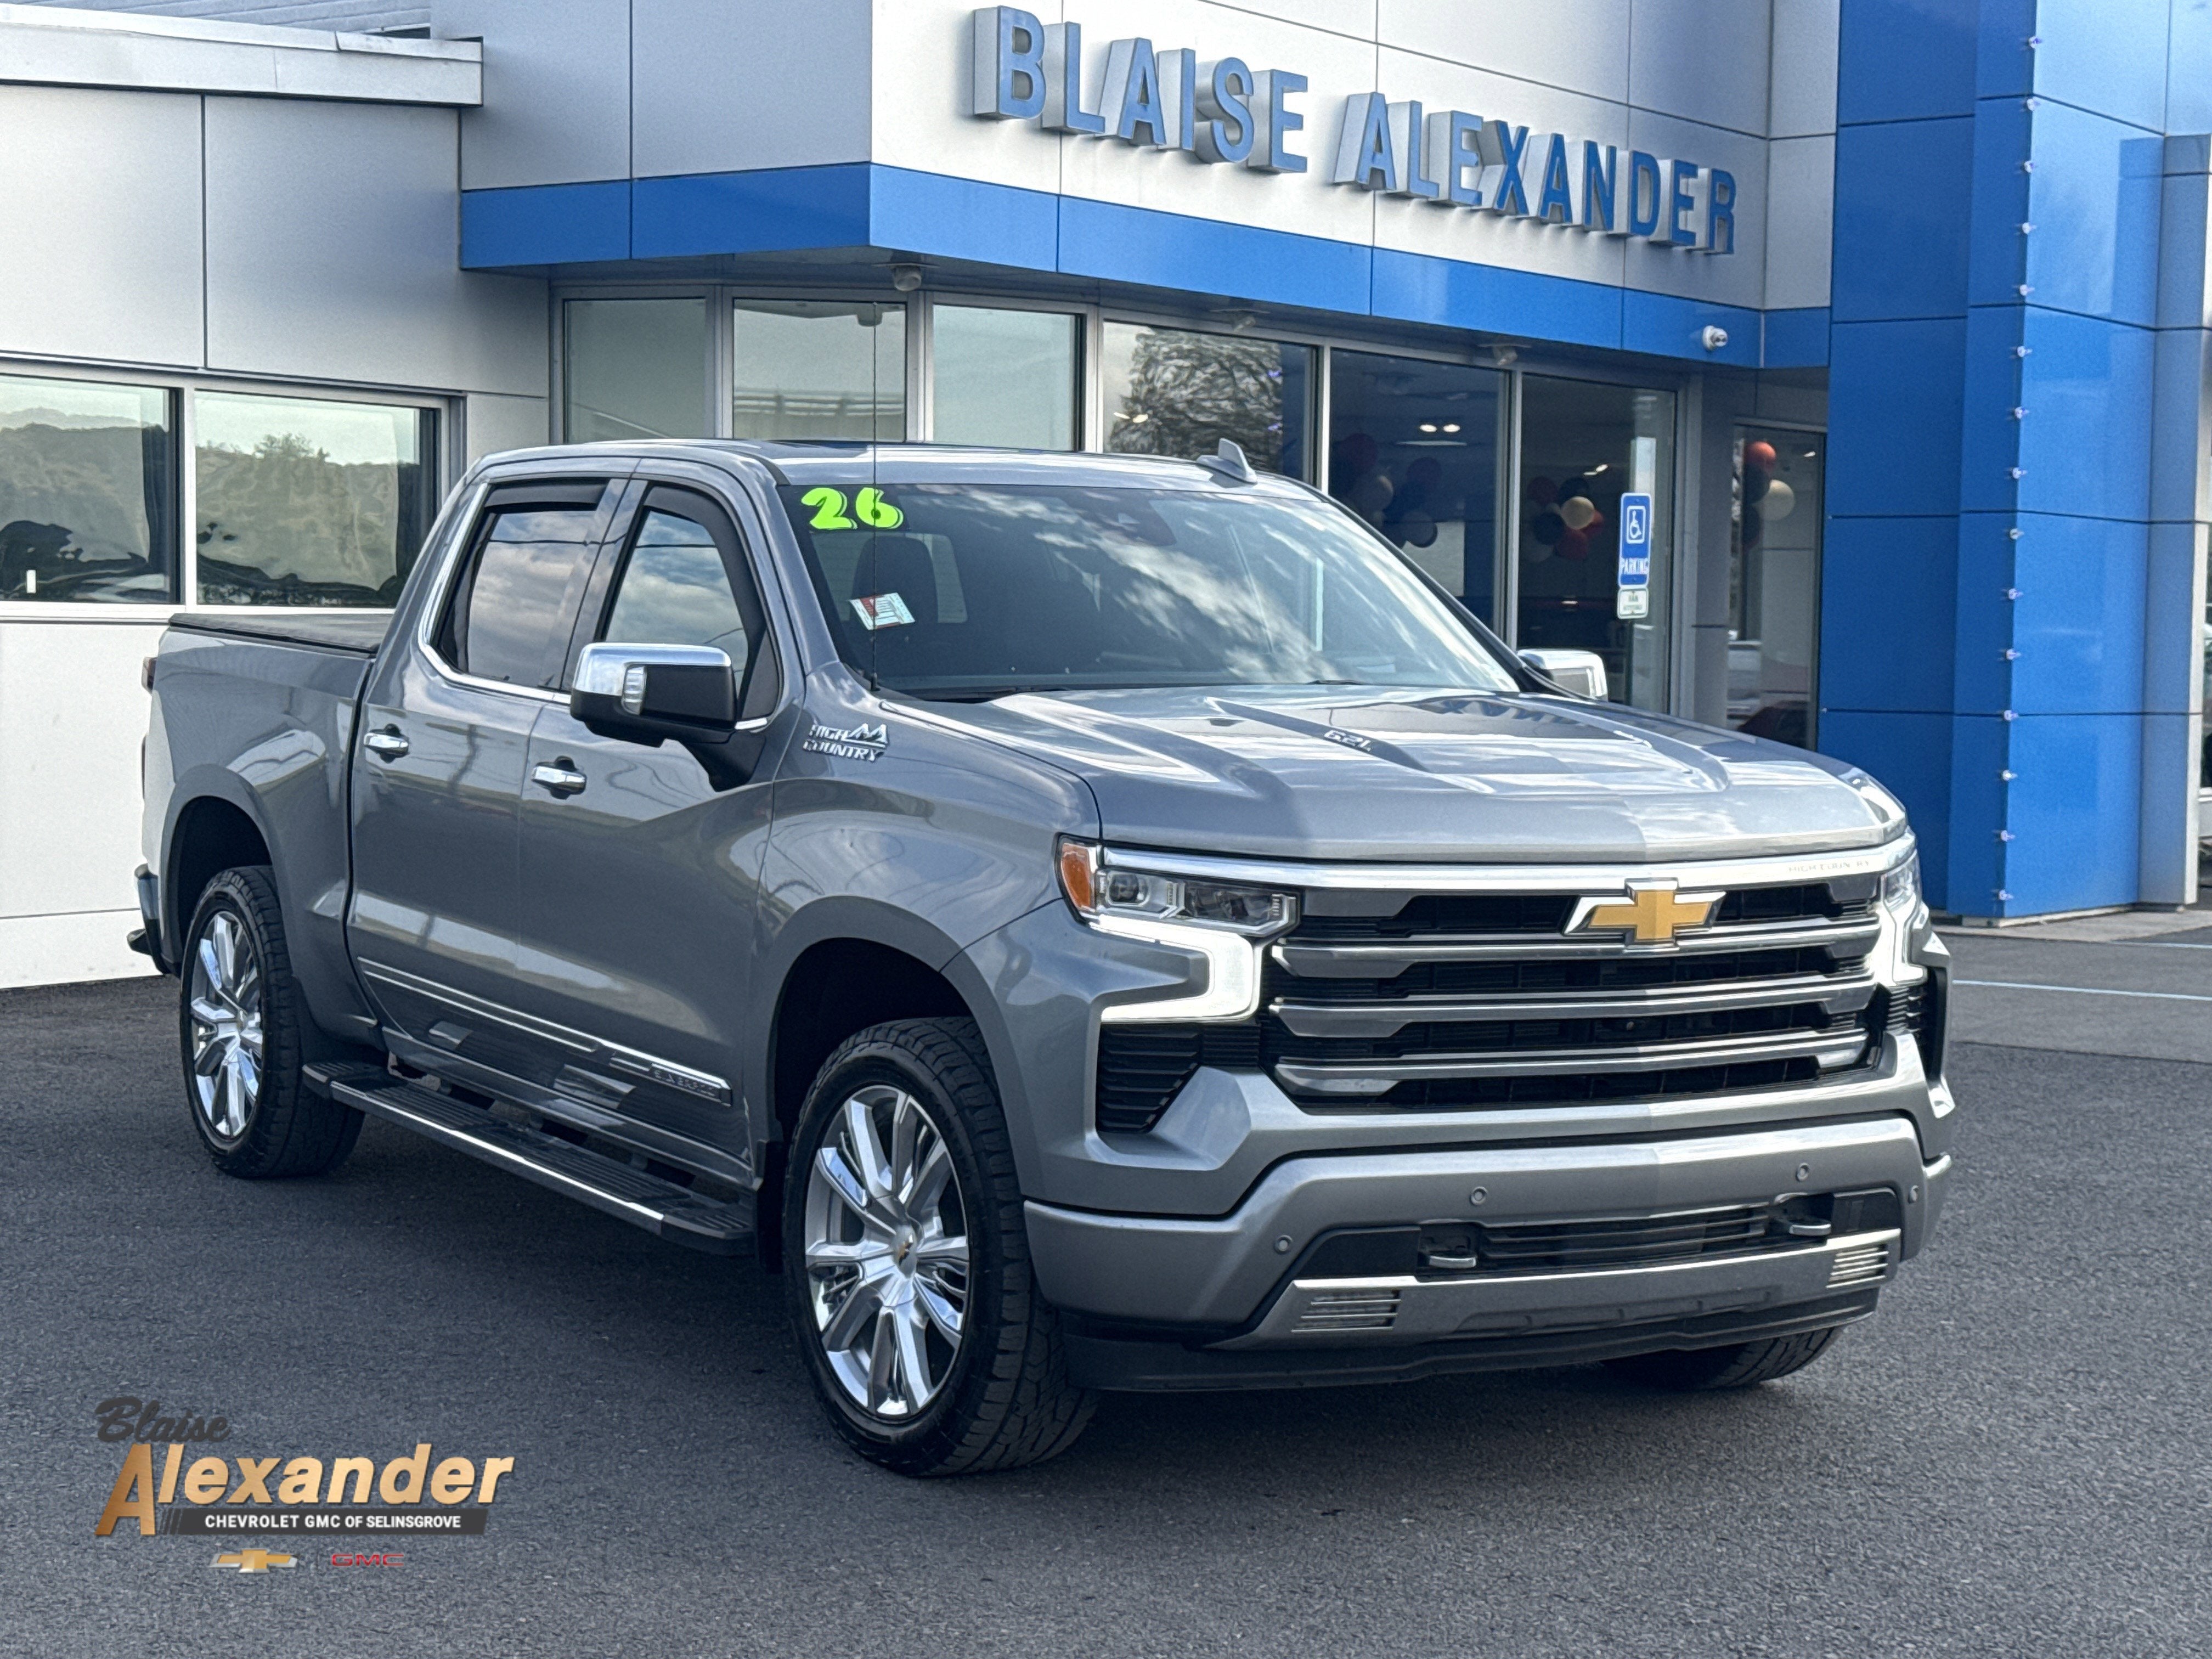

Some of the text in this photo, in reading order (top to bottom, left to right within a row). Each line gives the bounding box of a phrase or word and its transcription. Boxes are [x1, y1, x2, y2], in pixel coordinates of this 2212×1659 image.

[974, 7, 1737, 255] BLAISE ALEXANDER
[800, 487, 904, 530] 26
[1621, 557, 1649, 575] PARKING
[808, 724, 851, 741] HIGH
[802, 738, 884, 763] COUNTRY
